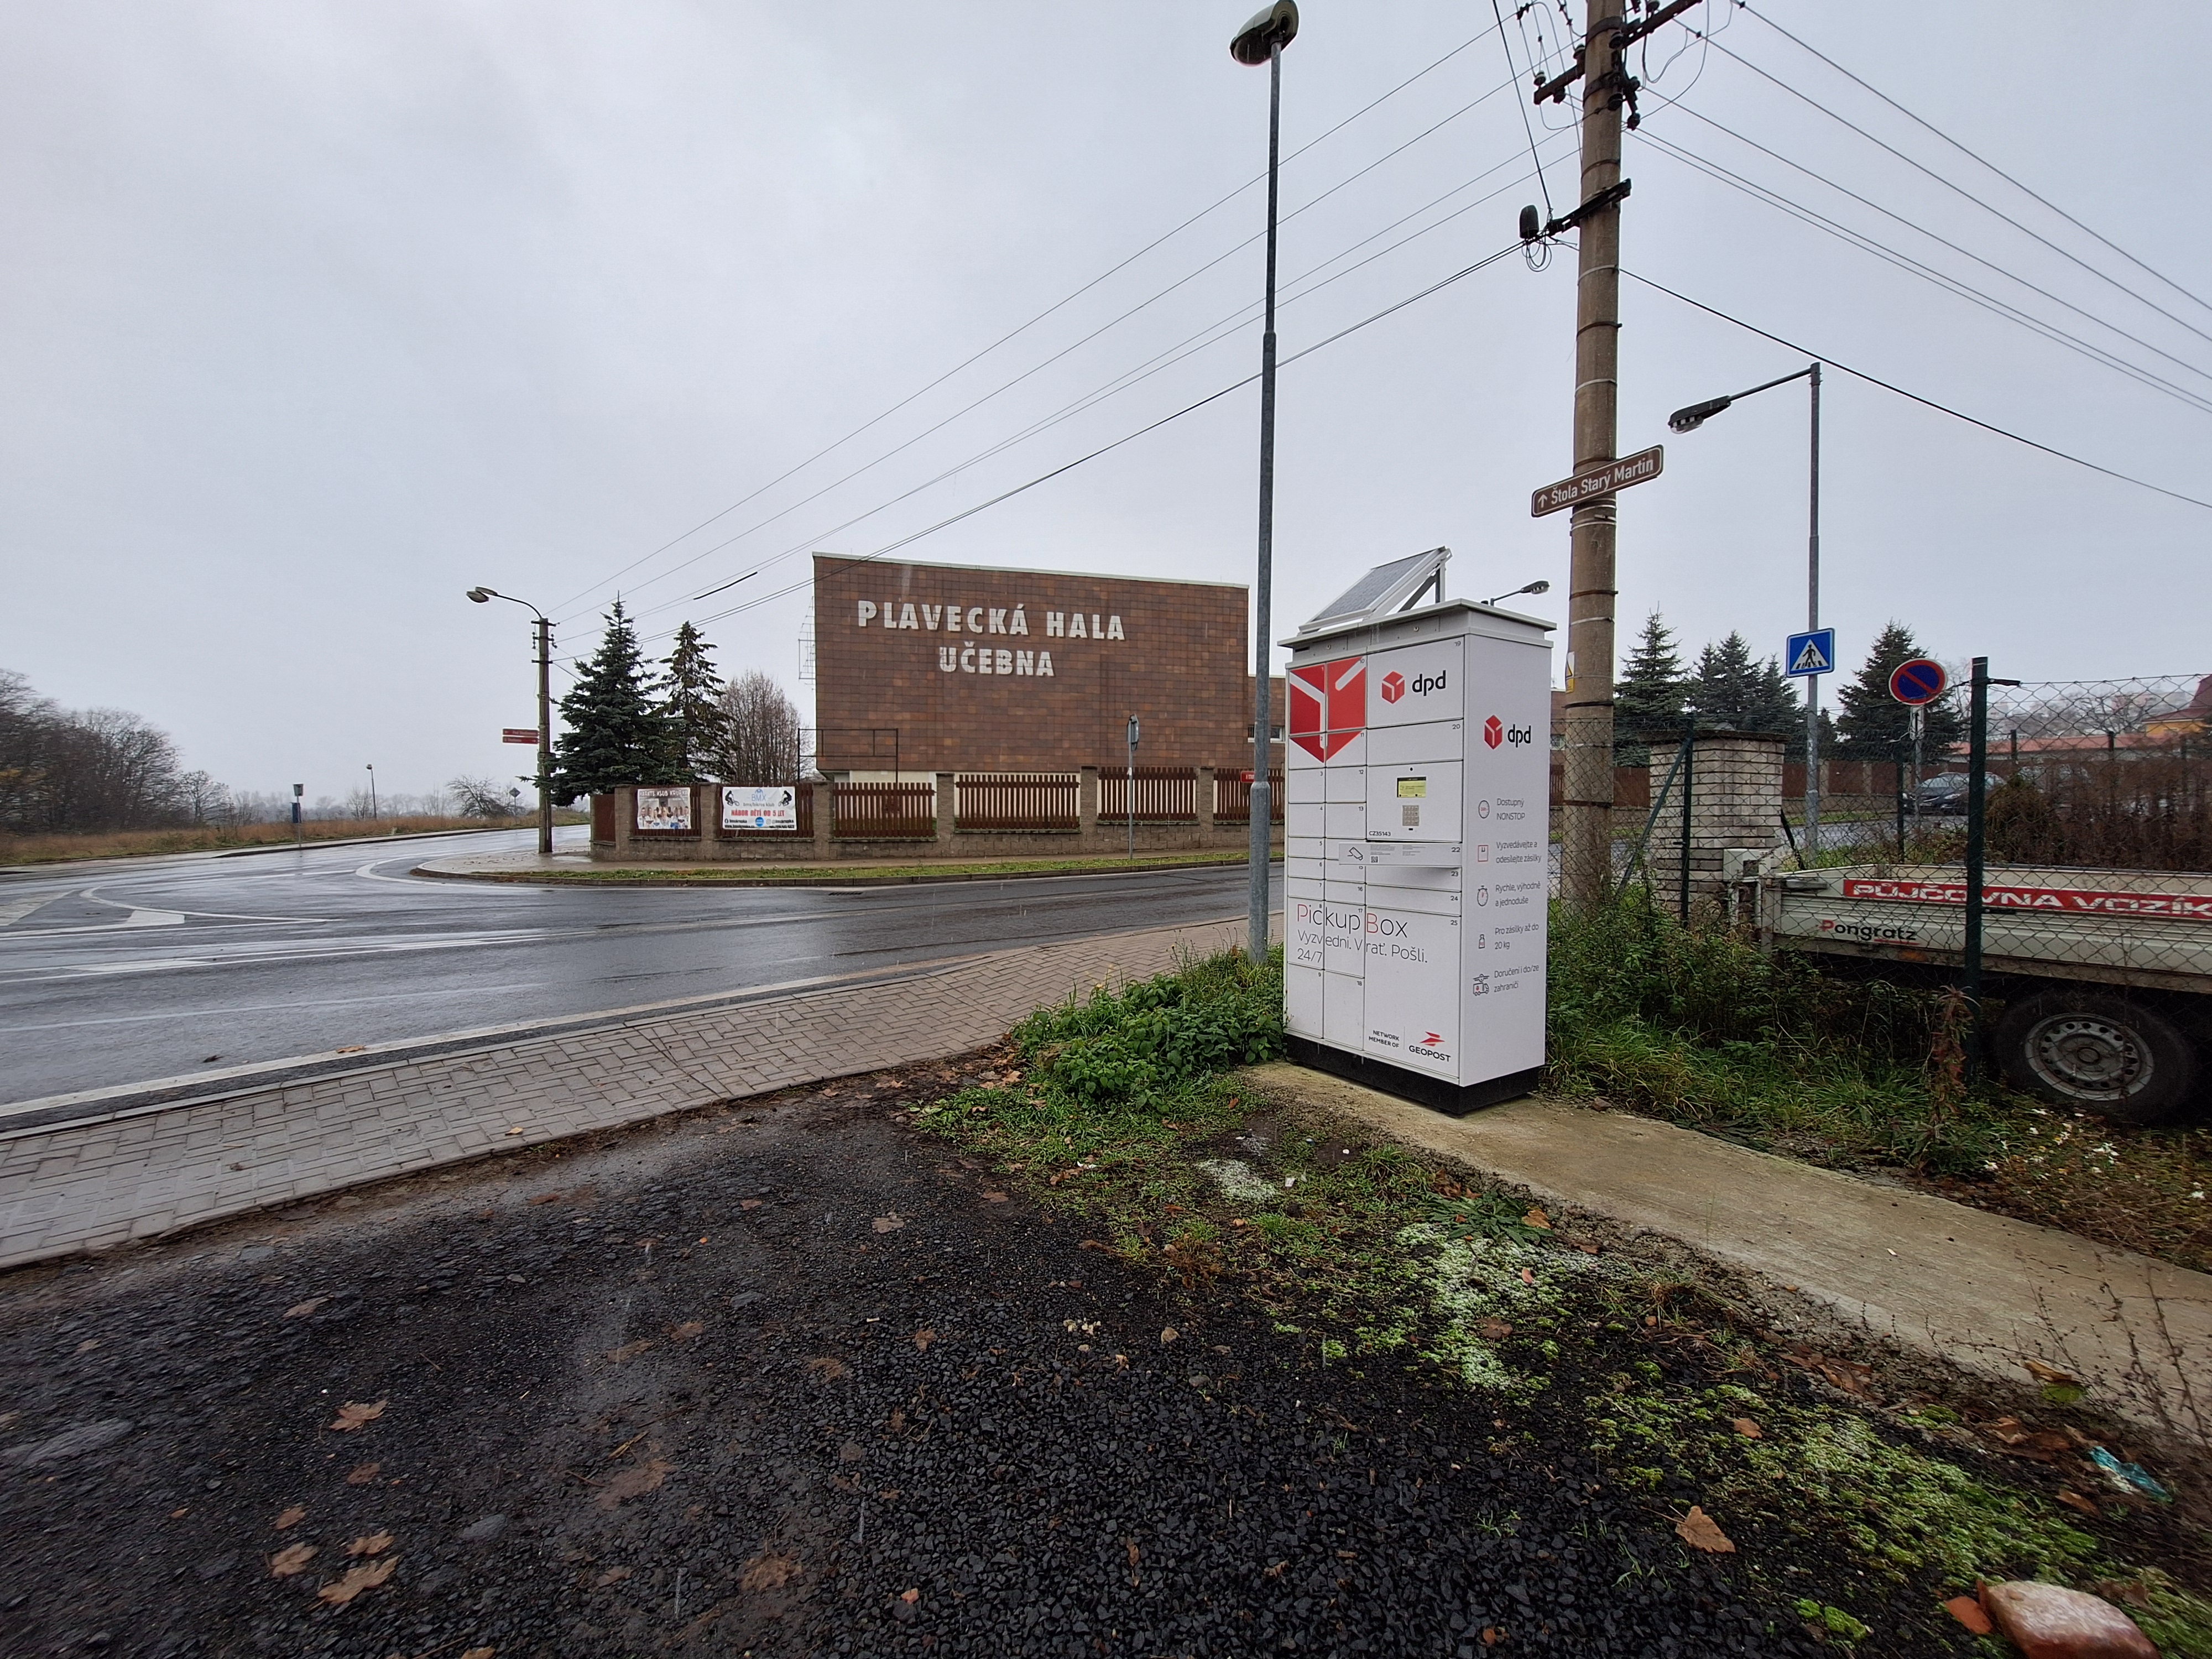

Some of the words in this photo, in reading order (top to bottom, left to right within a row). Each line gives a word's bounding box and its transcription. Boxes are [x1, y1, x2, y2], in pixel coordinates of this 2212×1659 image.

[1551, 484, 1578, 505] Štola
[1580, 471, 1611, 494] Starý
[1614, 458, 1653, 483] Martin
[858, 600, 1030, 636] PLAVECKÁ
[1047, 611, 1125, 641] HALA
[939, 641, 1055, 677] UČEBNA
[1412, 670, 1446, 696] dpd
[1507, 723, 1531, 748] dpd
[1496, 798, 1524, 807] Dostupný
[1496, 841, 1533, 851] Vyzvedávejte
[1496, 855, 1523, 864] odesílejte
[1524, 854, 1542, 863] zásilky
[1496, 884, 1516, 894] Rychle,
[1517, 881, 1541, 891] výhodně
[1499, 896, 1529, 908] jednoduše
[1506, 925, 1524, 934] zásilky
[1525, 924, 1531, 932] až
[1820, 919, 1917, 941] Pongratz
[1297, 929, 1352, 950] Vyzvedni.
[1391, 944, 1428, 963] Pošli.
[1504, 941, 1510, 950] kg
[1297, 948, 1323, 963] 24/7
[1494, 966, 1520, 978] Doručení
[1523, 964, 1540, 973] do/ze
[1369, 1036, 1391, 1046] MEMBER
[1373, 1030, 1400, 1041] NETWORK
[1408, 1045, 1451, 1062] GEOPOST
